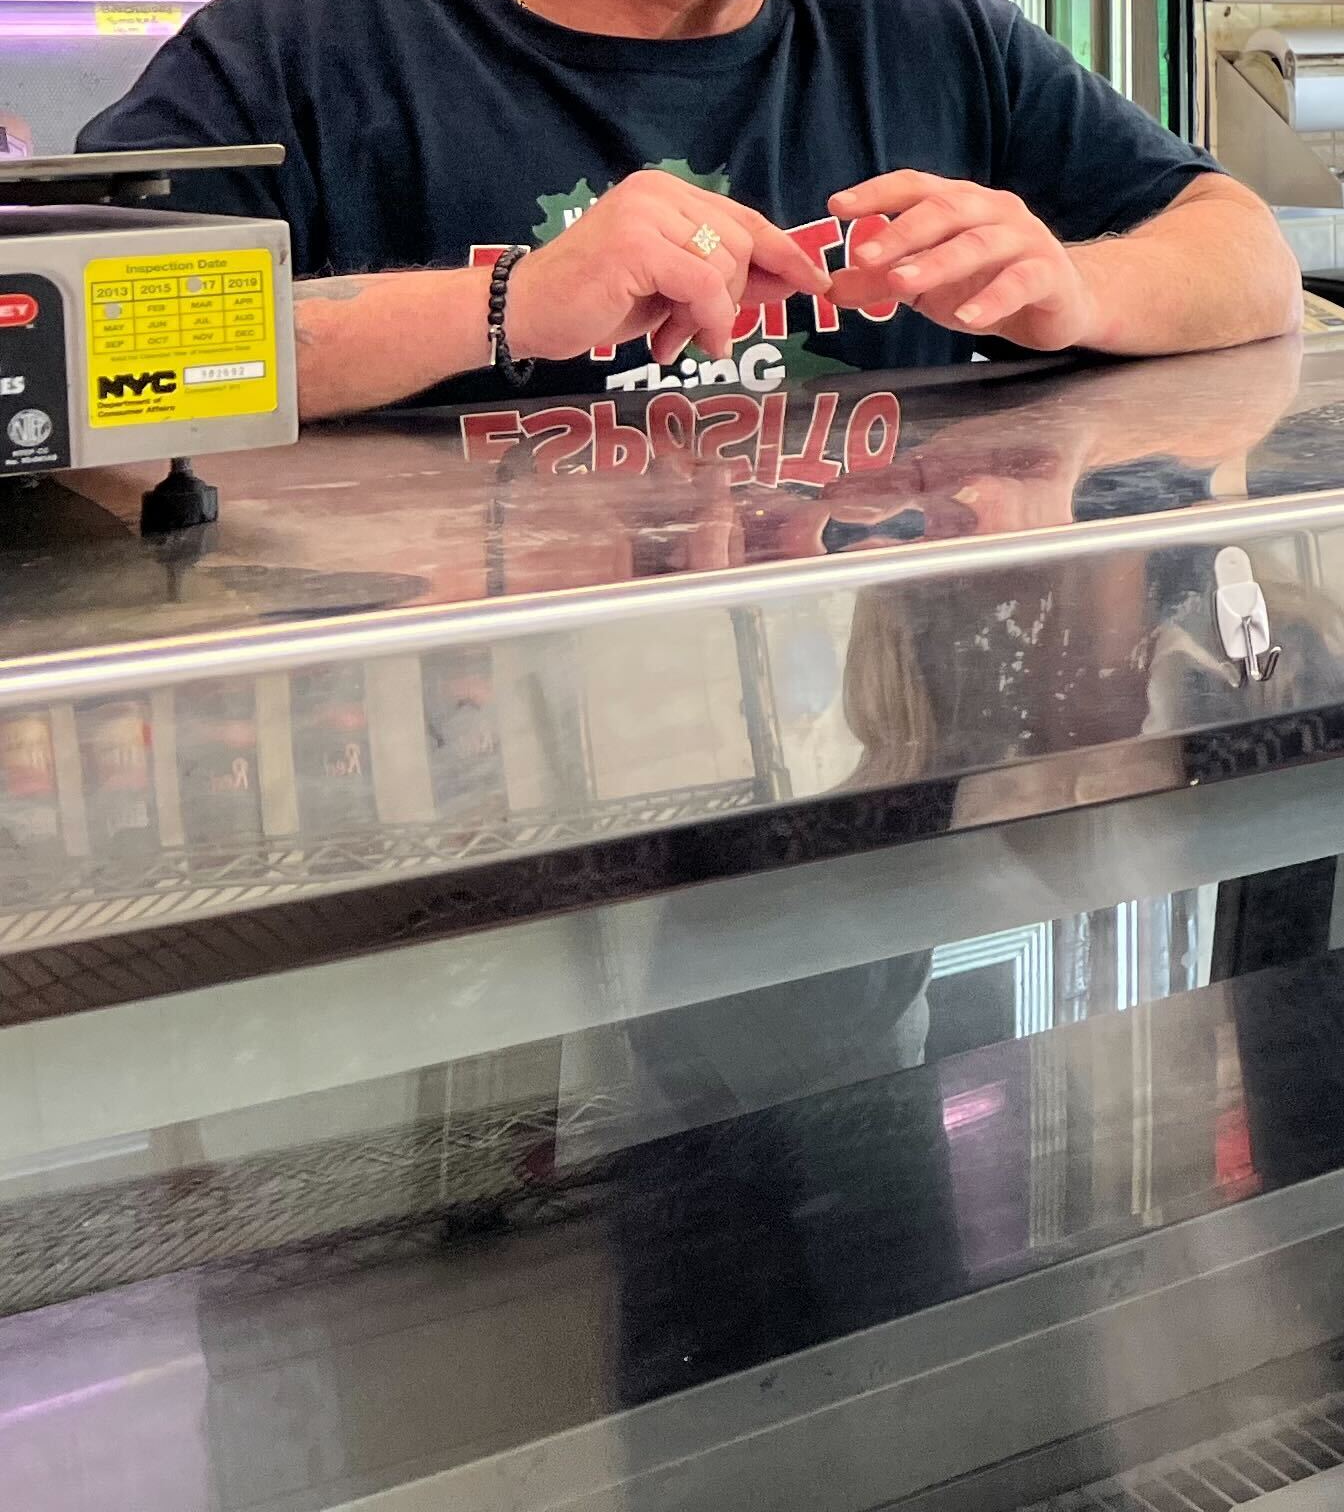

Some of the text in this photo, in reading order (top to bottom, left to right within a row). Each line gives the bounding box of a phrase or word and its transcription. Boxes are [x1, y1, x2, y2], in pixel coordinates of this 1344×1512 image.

[126, 258, 228, 275] Inspection Date
[96, 287, 128, 299] 2013
[140, 283, 172, 296] 2015
[228, 277, 258, 290] 2019
[97, 369, 177, 400] NYC
